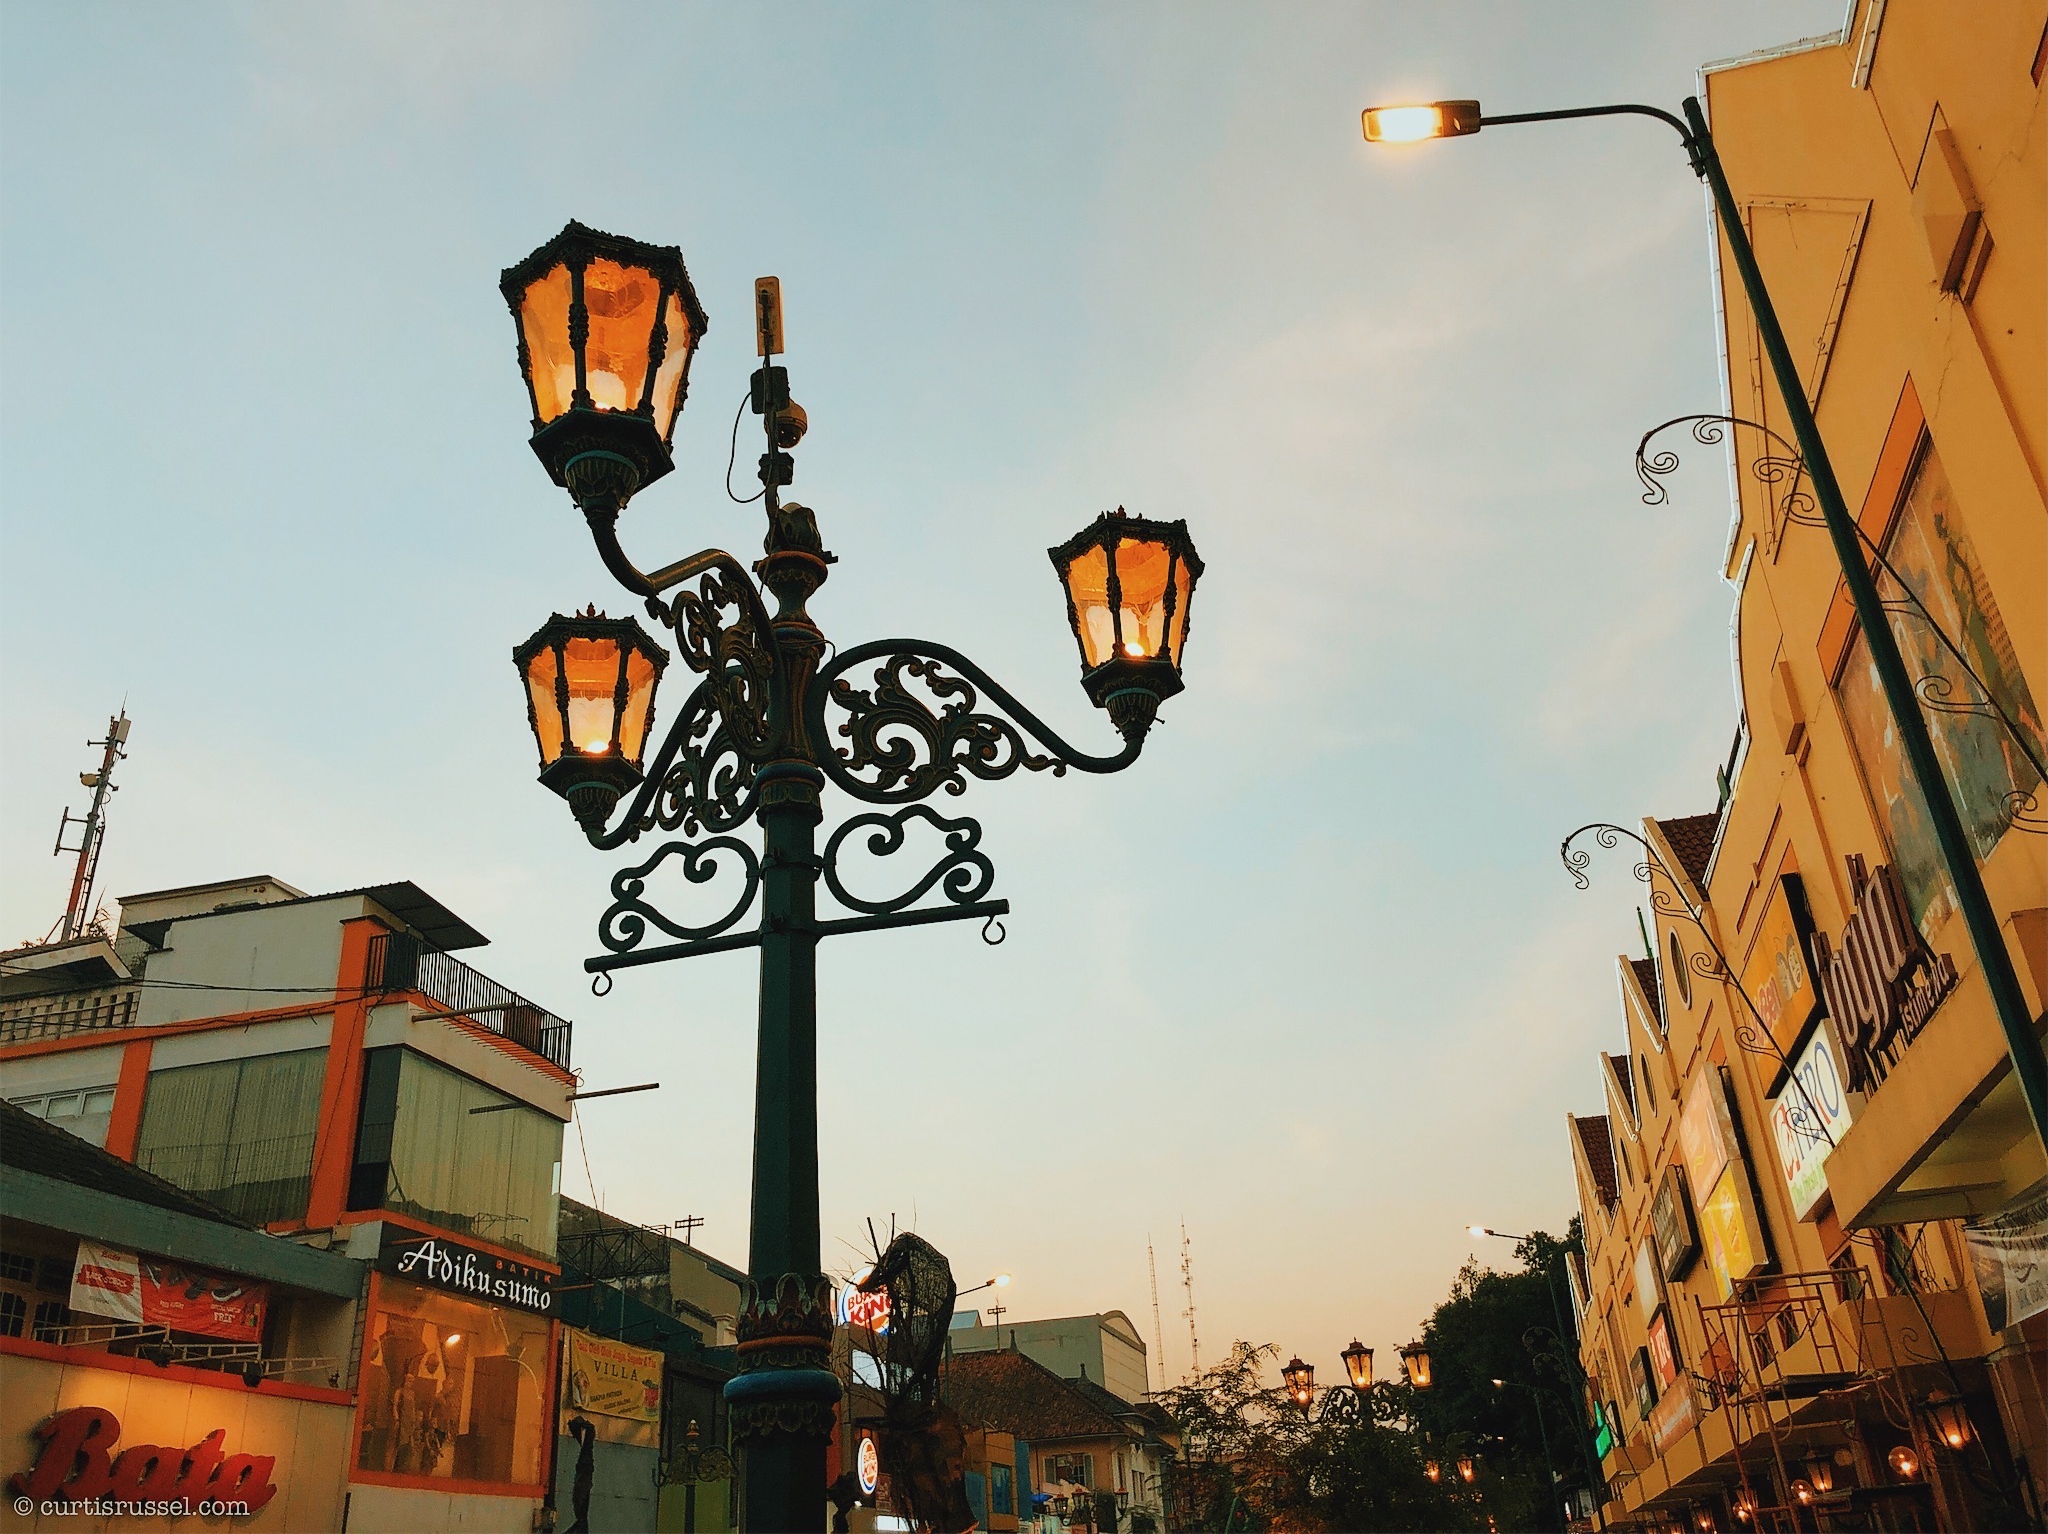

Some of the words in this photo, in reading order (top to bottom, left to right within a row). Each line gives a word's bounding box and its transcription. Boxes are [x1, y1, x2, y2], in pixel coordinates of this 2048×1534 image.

[397, 1240, 551, 1311] Adikusumo
[495, 1259, 552, 1285] BATIK
[593, 1360, 638, 1382] VILLA
[8, 1406, 278, 1513] Bata
